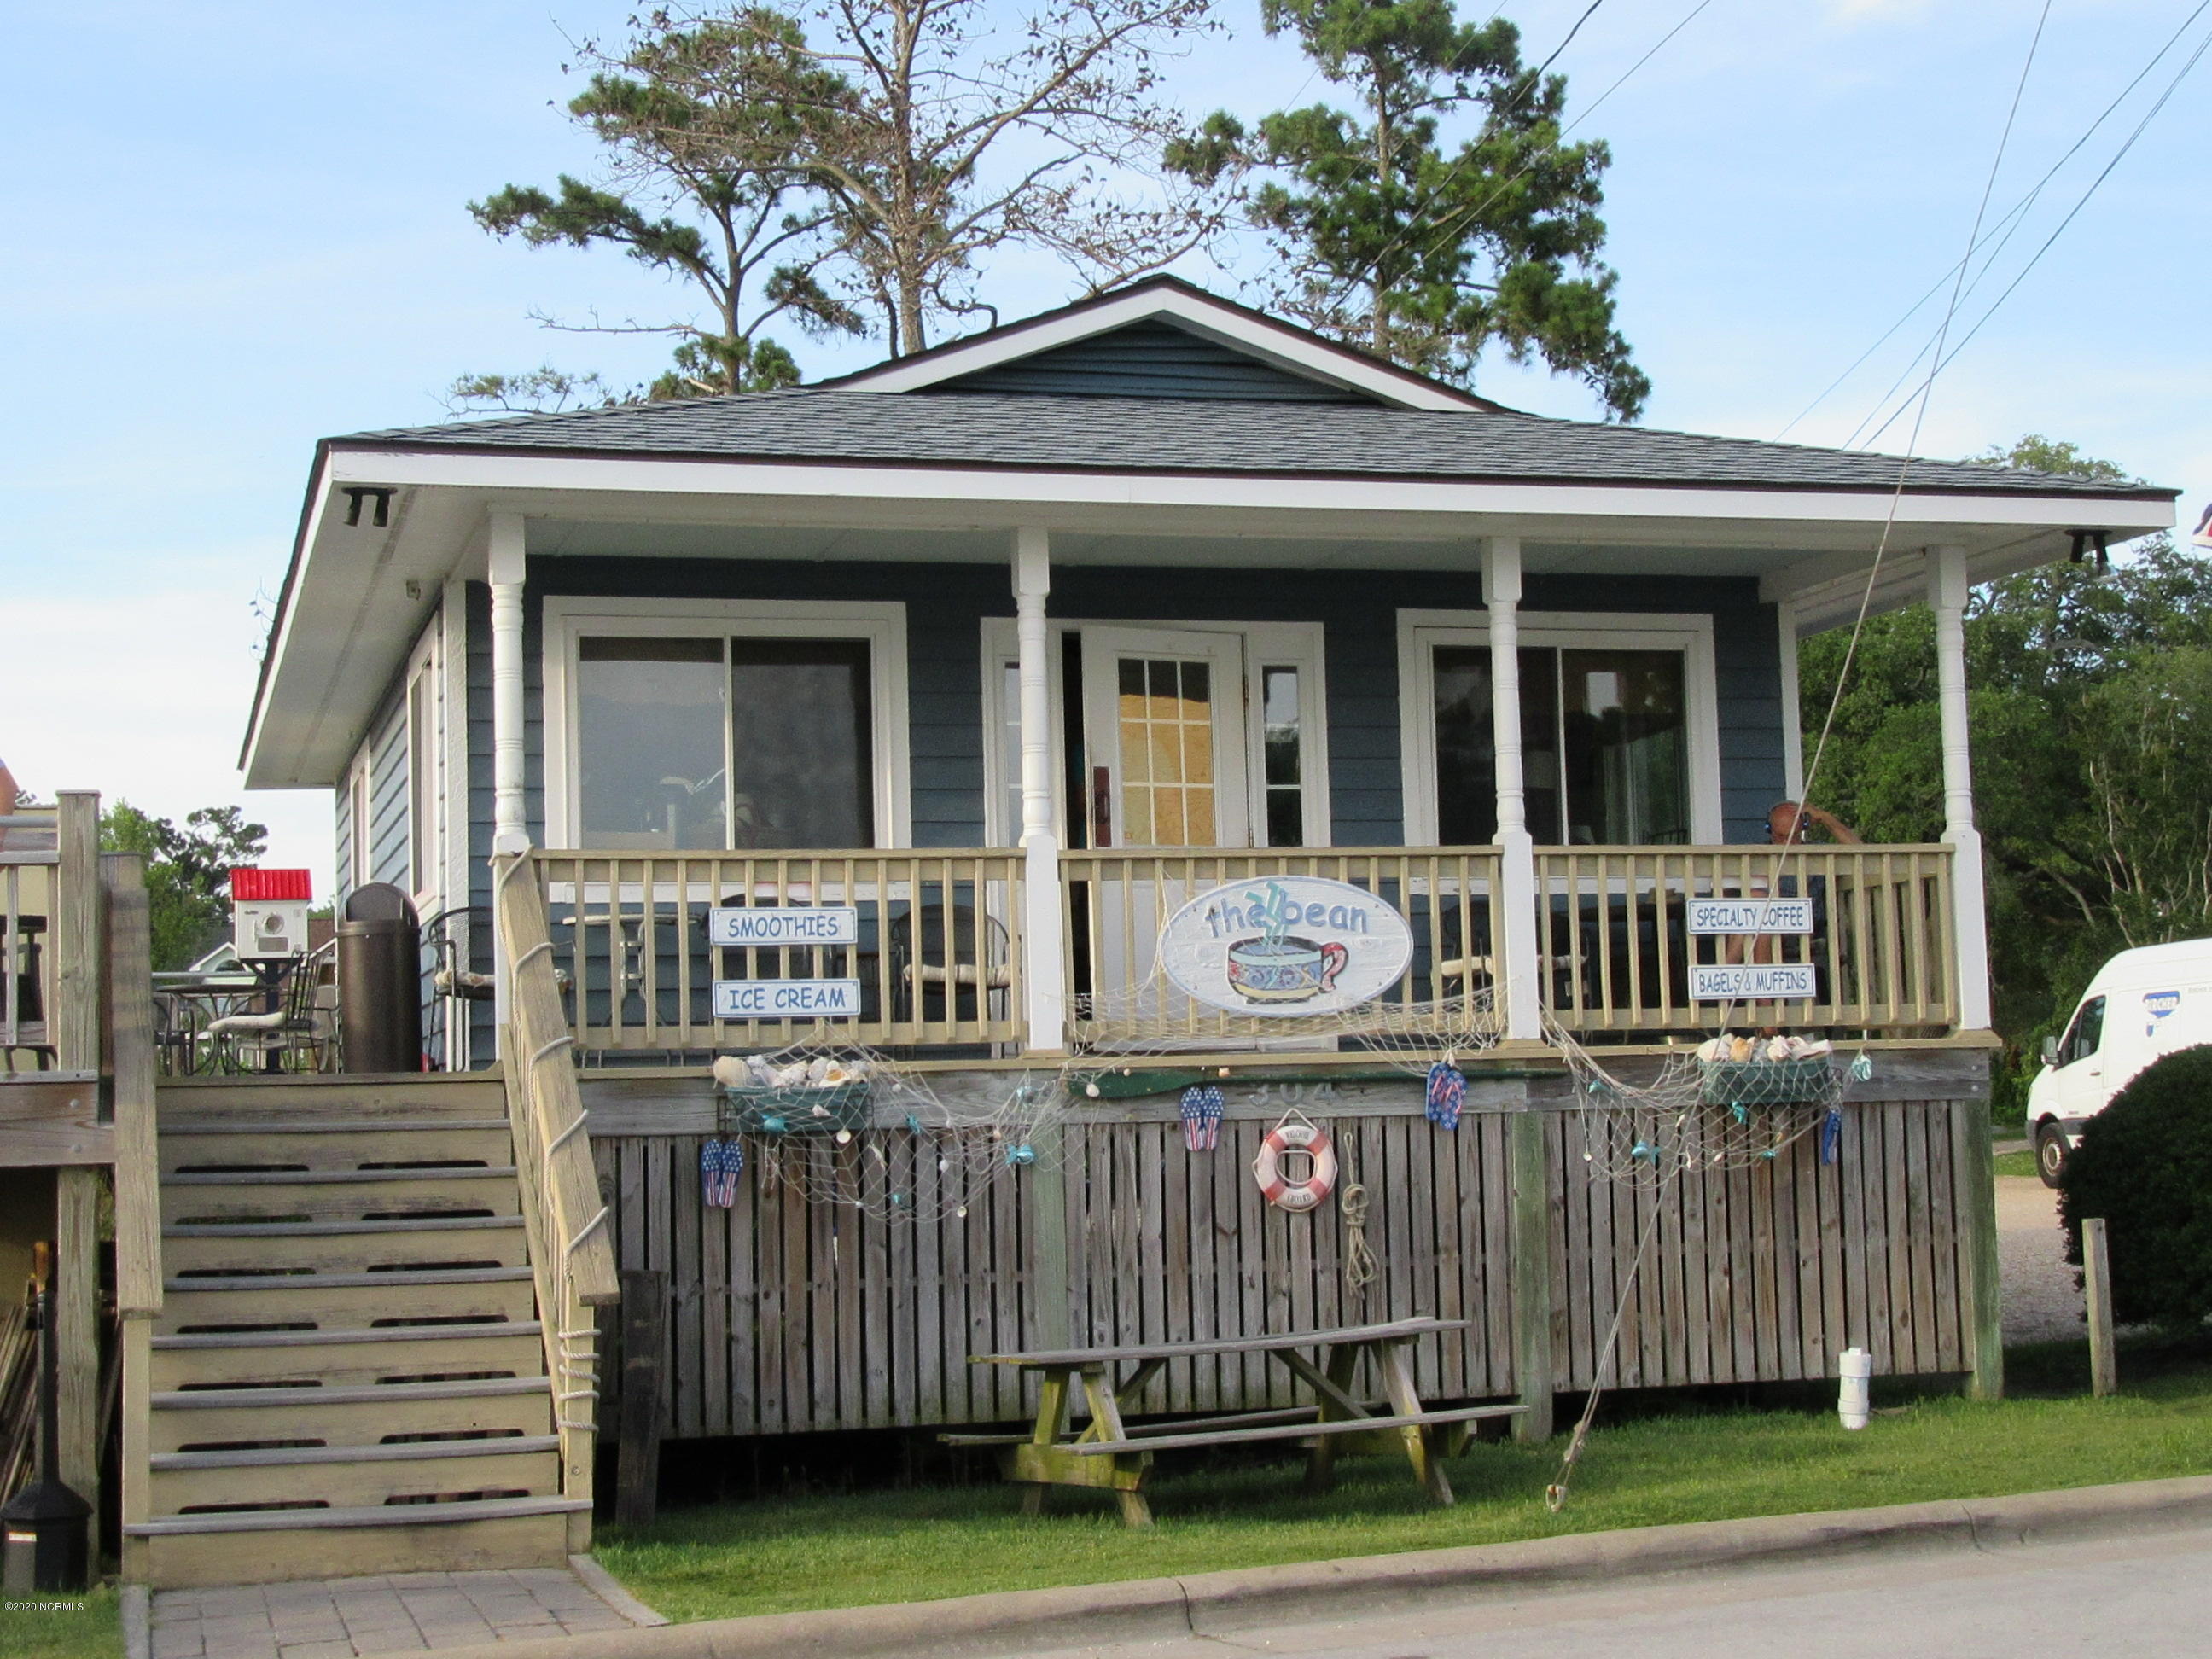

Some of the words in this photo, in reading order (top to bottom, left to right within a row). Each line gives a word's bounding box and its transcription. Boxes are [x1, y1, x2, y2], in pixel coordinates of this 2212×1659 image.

[1204, 897, 1268, 938] the
[1278, 886, 1368, 934] bean
[1697, 907, 1757, 928] SPECIALTY
[728, 915, 839, 937] SMOOTHIES
[1699, 973, 1741, 992] BAGELS
[1756, 971, 1807, 991] MUFFINS
[729, 988, 765, 1010] ICE
[775, 987, 846, 1009] CREAM
